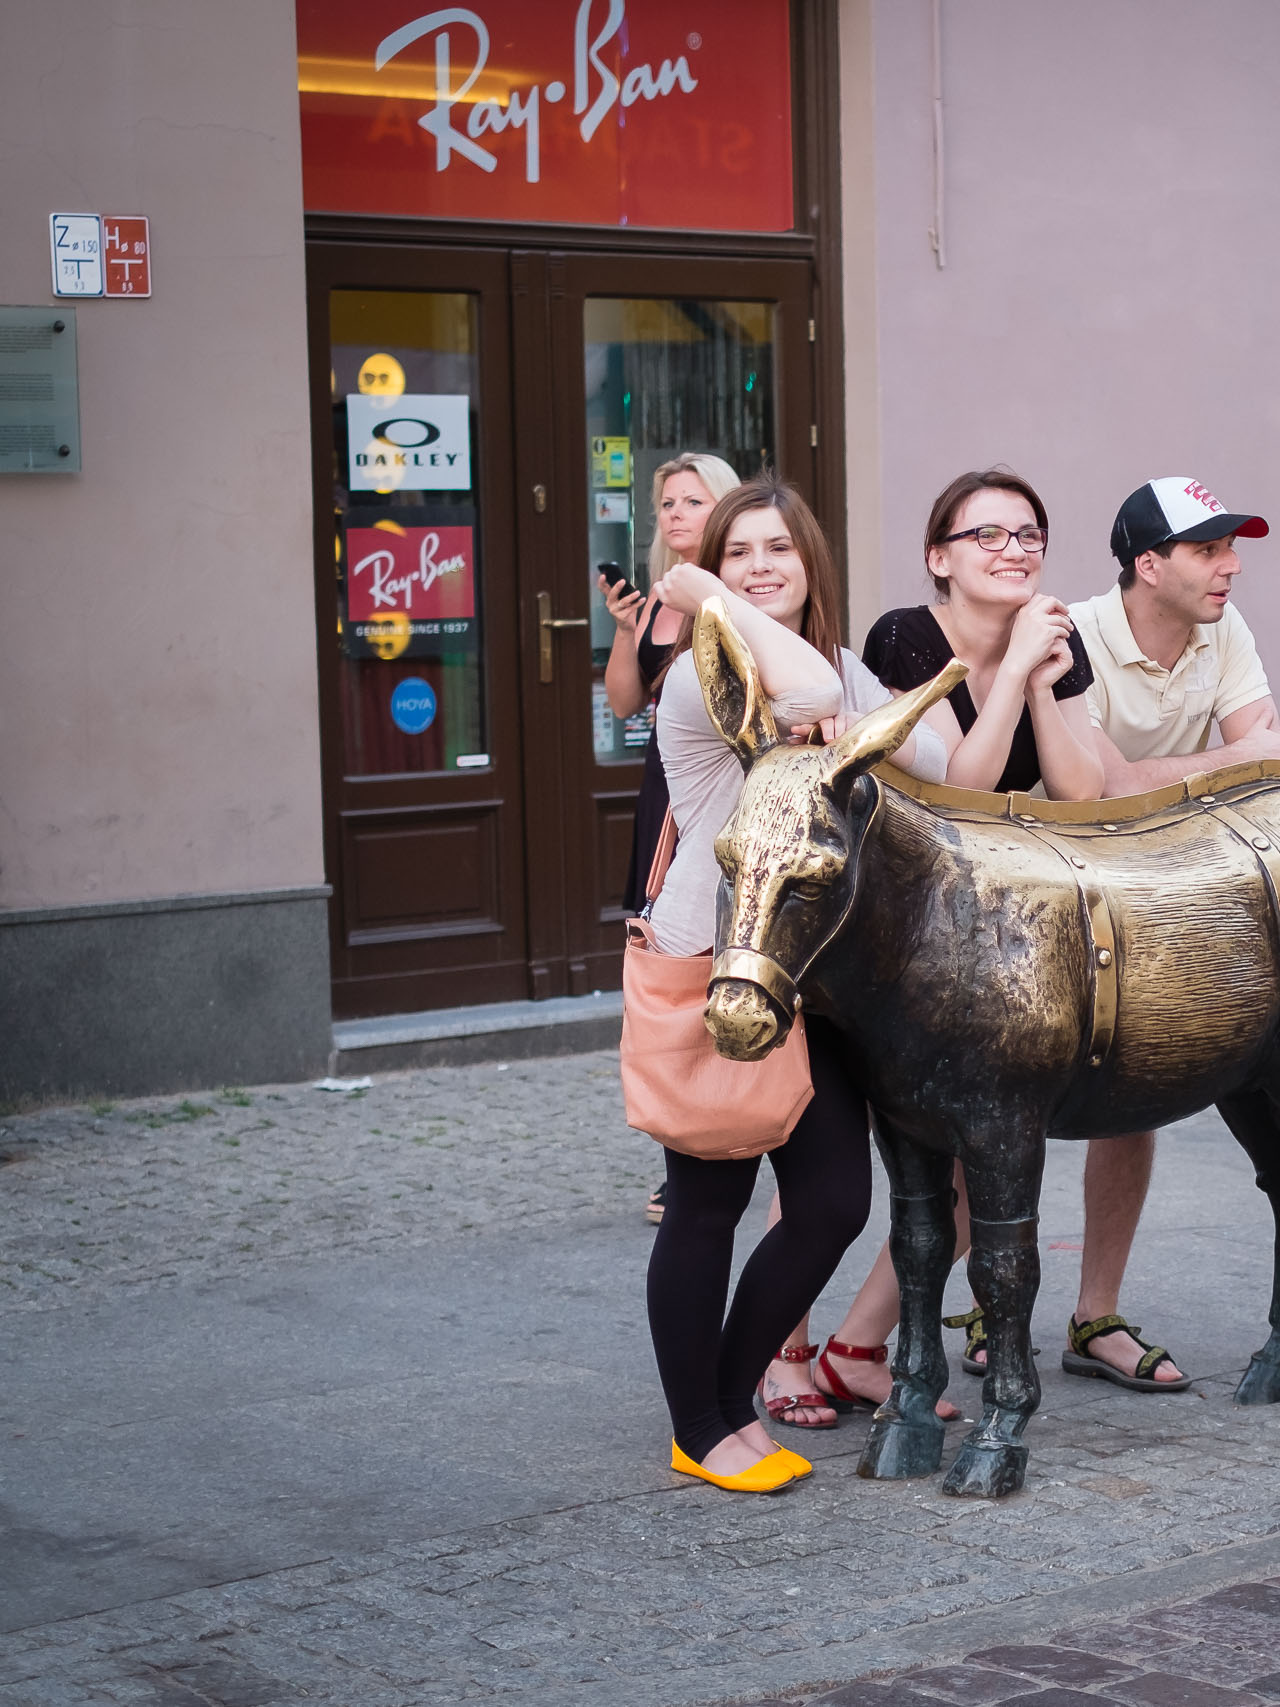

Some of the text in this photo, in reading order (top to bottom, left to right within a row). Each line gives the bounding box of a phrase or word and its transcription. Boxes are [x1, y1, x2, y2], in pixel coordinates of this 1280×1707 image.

[56, 225, 70, 247] Z
[105, 226, 119, 249] H
[356, 453, 458, 467] OAKLEY
[408, 623, 440, 634] SINCE
[443, 622, 468, 633] 1937
[397, 698, 432, 710] HOYA
